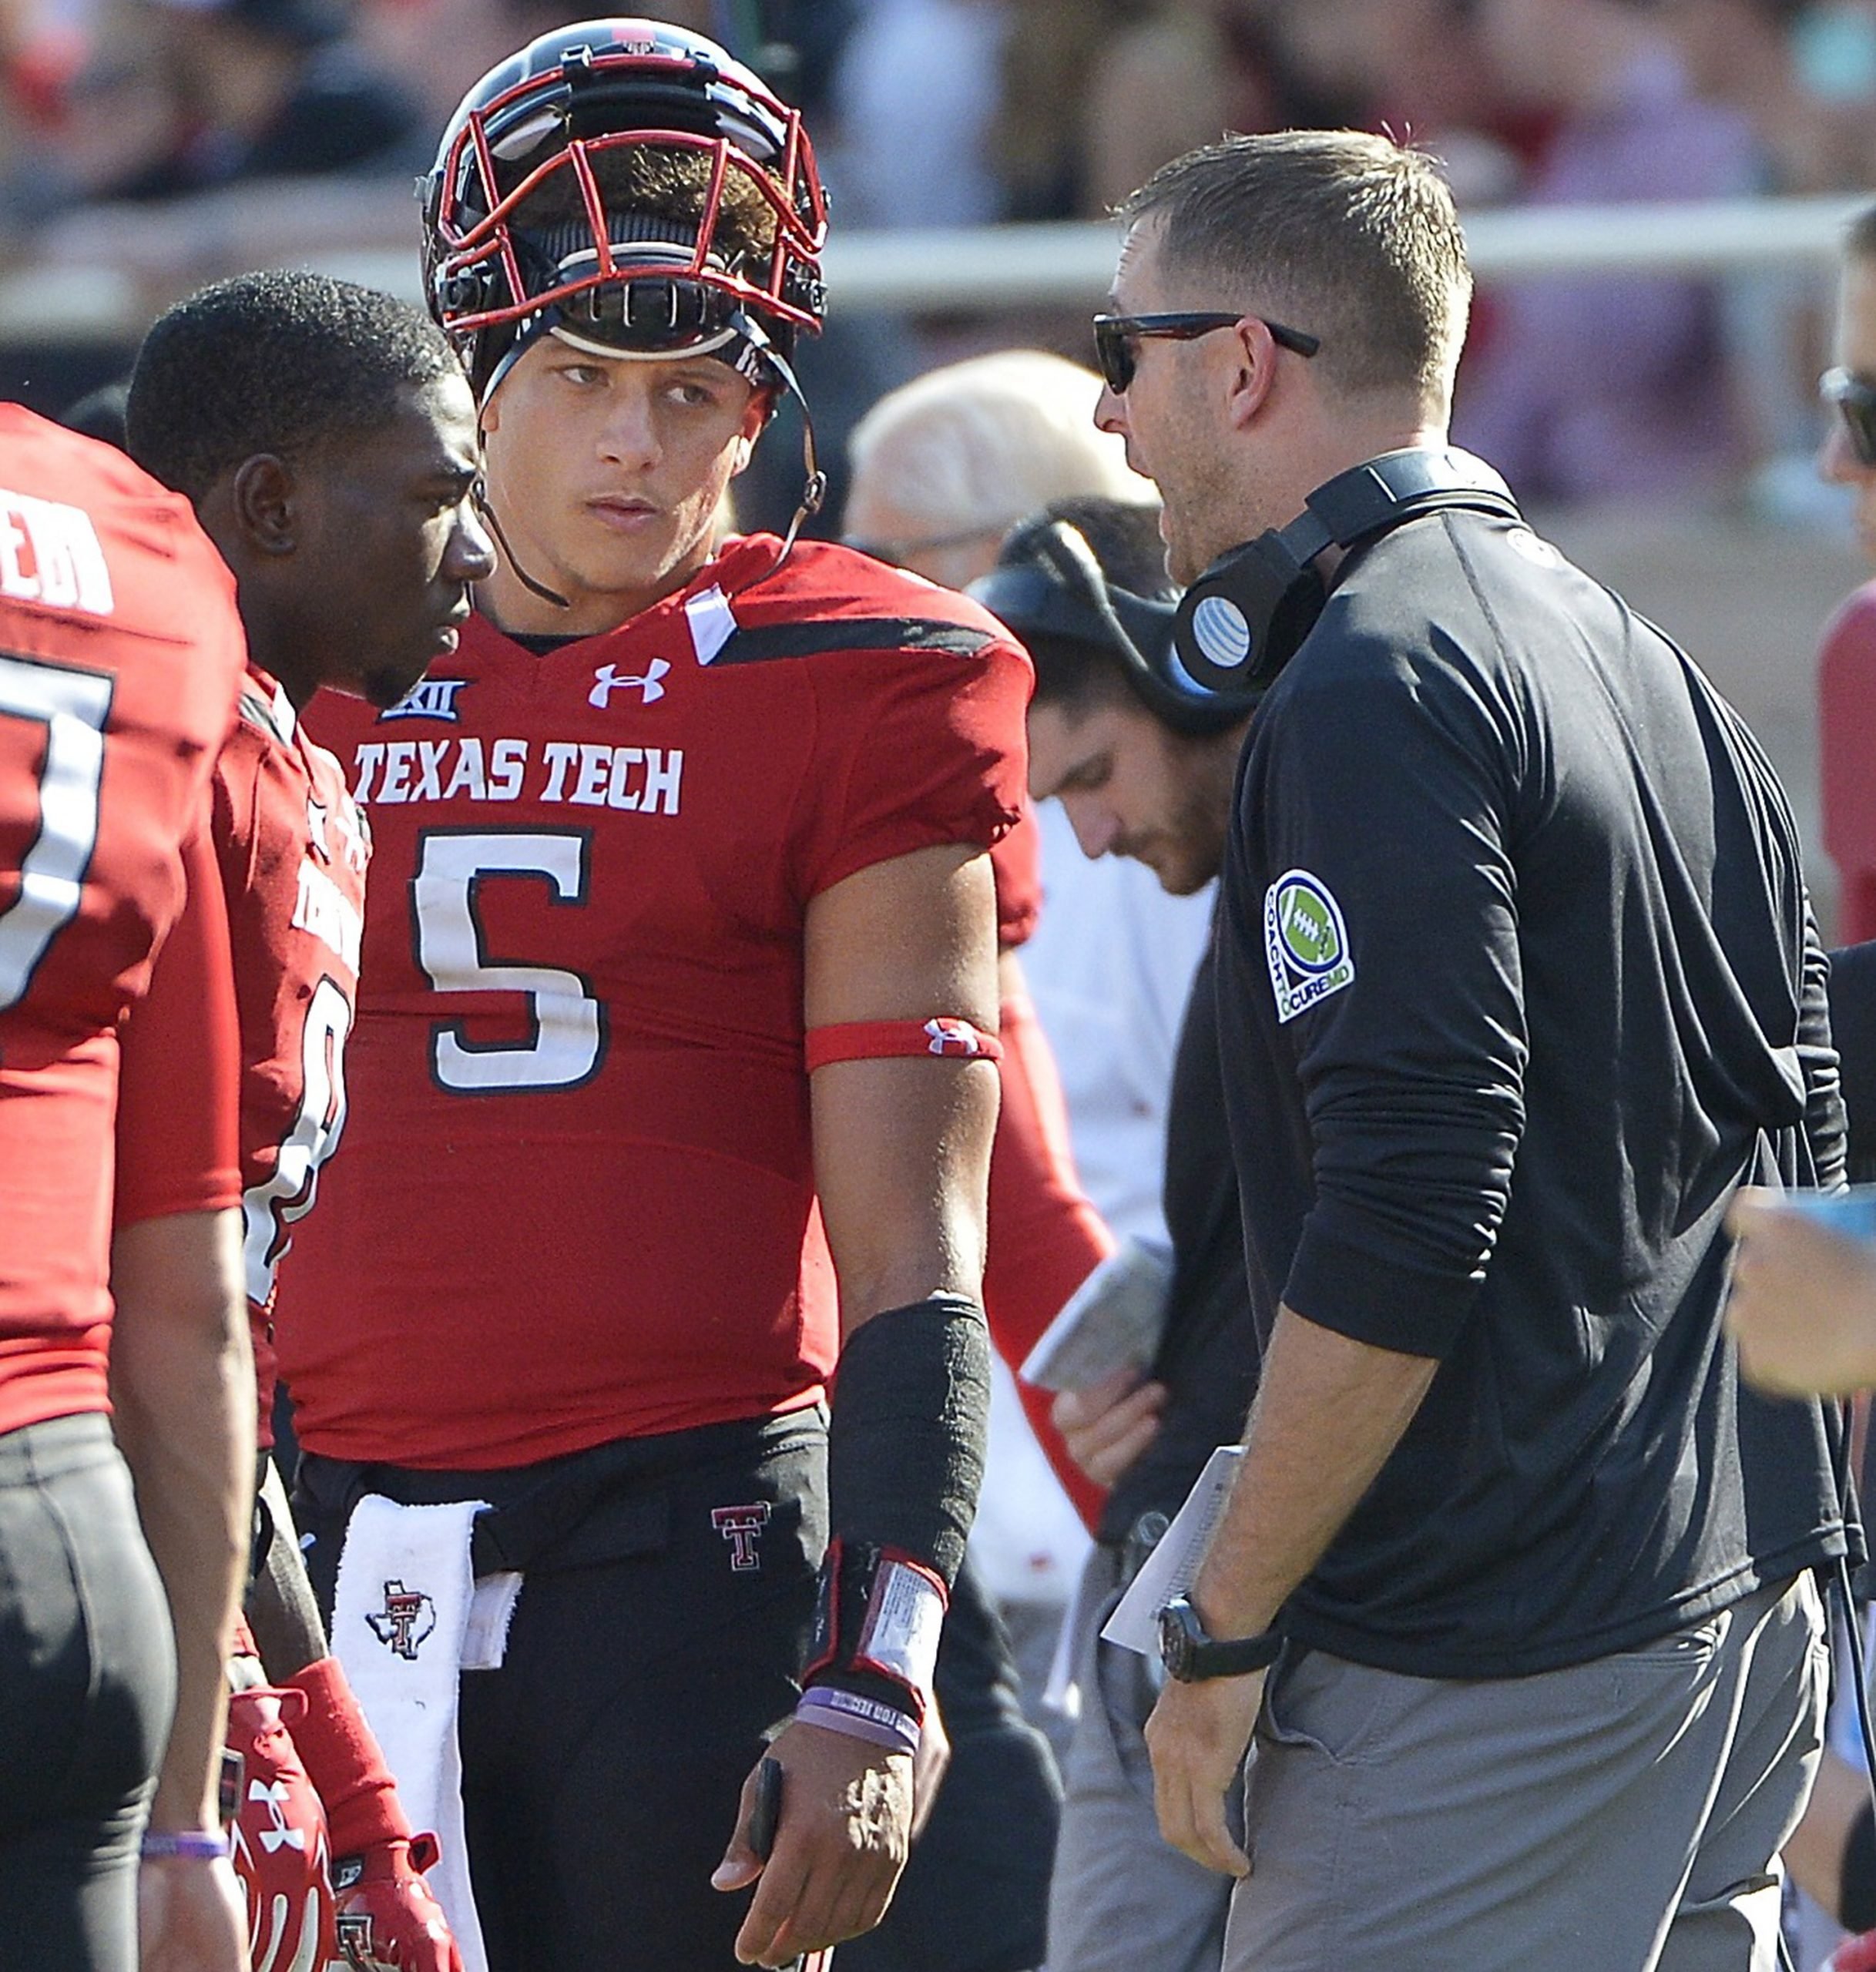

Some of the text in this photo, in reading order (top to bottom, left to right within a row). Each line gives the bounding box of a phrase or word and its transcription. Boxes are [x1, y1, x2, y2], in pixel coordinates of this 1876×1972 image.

[354, 738, 683, 815] TEXAS TECH
[414, 833, 599, 1089] 5
